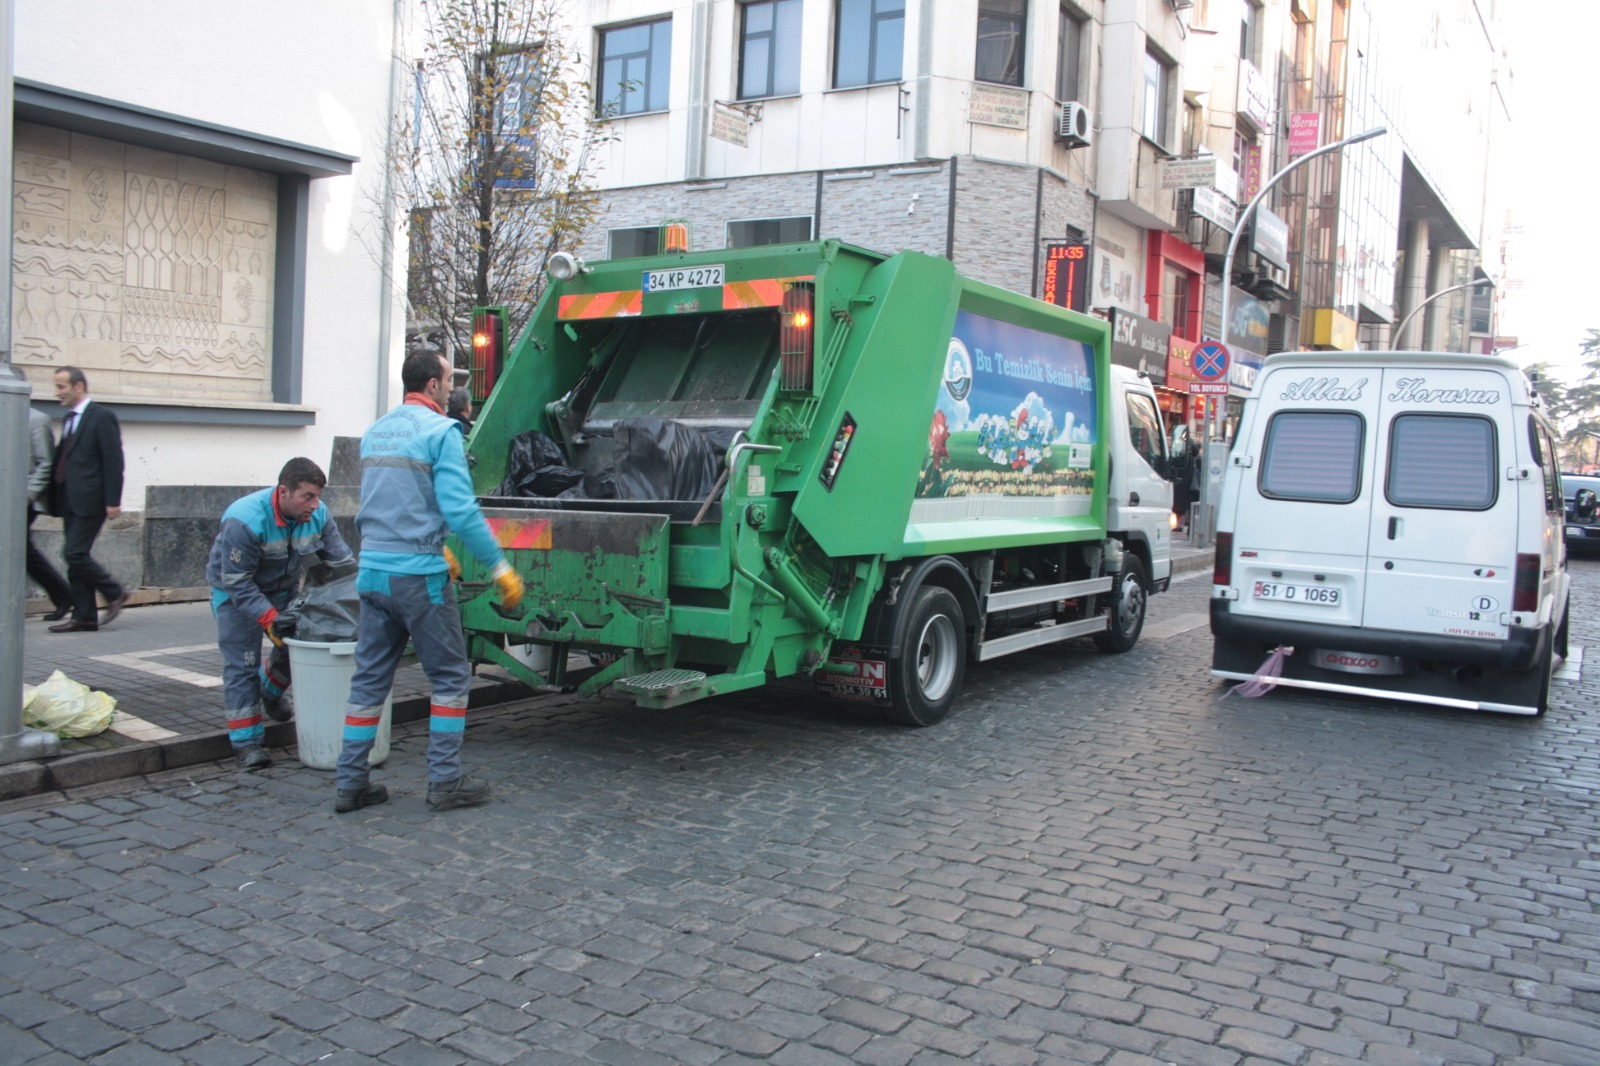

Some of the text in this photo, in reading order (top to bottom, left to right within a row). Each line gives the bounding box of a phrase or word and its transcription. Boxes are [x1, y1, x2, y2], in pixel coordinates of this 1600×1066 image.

[1291, 115, 1318, 128] Berna
[1050, 246, 1084, 259] 11:35
[650, 269, 721, 289] 34 KP 4272
[1114, 313, 1137, 347] ESC
[1141, 332, 1156, 352] Mobile
[975, 348, 1092, 395] Bu Temizlik Senin İçin
[1190, 384, 1228, 393] YOL BOYUNCA
[1280, 377, 1500, 404] Allah Korusun
[229, 548, 242, 563] 56
[1261, 584, 1339, 602] 61 D 1069
[1479, 597, 1491, 610] D
[1426, 607, 1466, 620] Transit
[1469, 611, 1480, 621] 12
[244, 651, 256, 666] 56
[834, 684, 856, 695] 334
[857, 686, 871, 697] 39
[874, 688, 887, 698] 61
